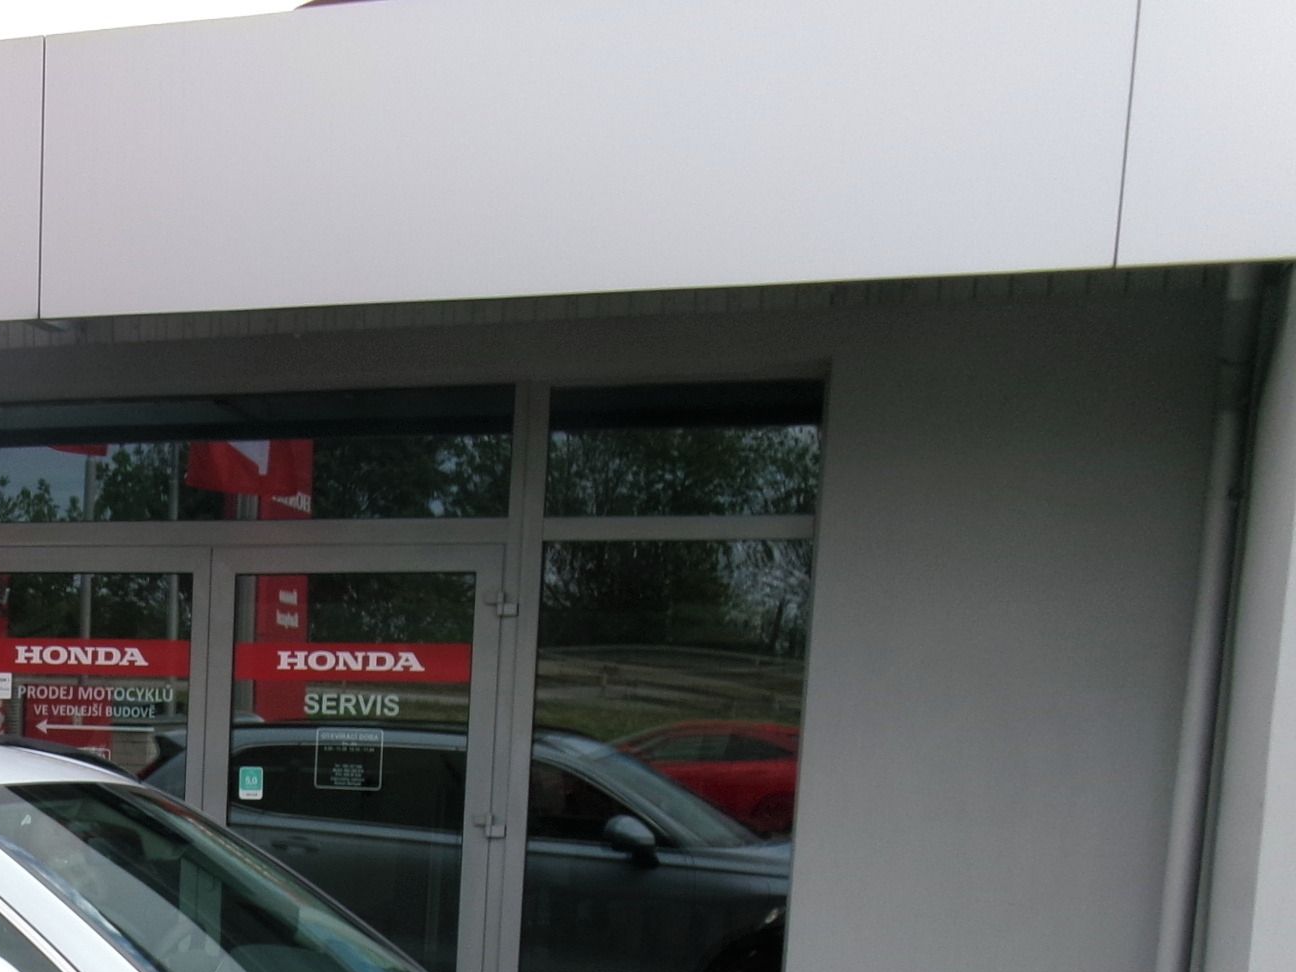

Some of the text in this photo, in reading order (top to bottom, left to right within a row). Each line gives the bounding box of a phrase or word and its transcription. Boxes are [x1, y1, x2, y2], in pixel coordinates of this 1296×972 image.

[15, 645, 149, 666] HONDA
[277, 651, 425, 672] HONDA
[18, 684, 173, 702] PRODEJ MOTOCYKLŮ
[34, 702, 155, 718] VE VEDLEJŠÍ BUDOVĚ
[304, 694, 400, 716] SERVIS
